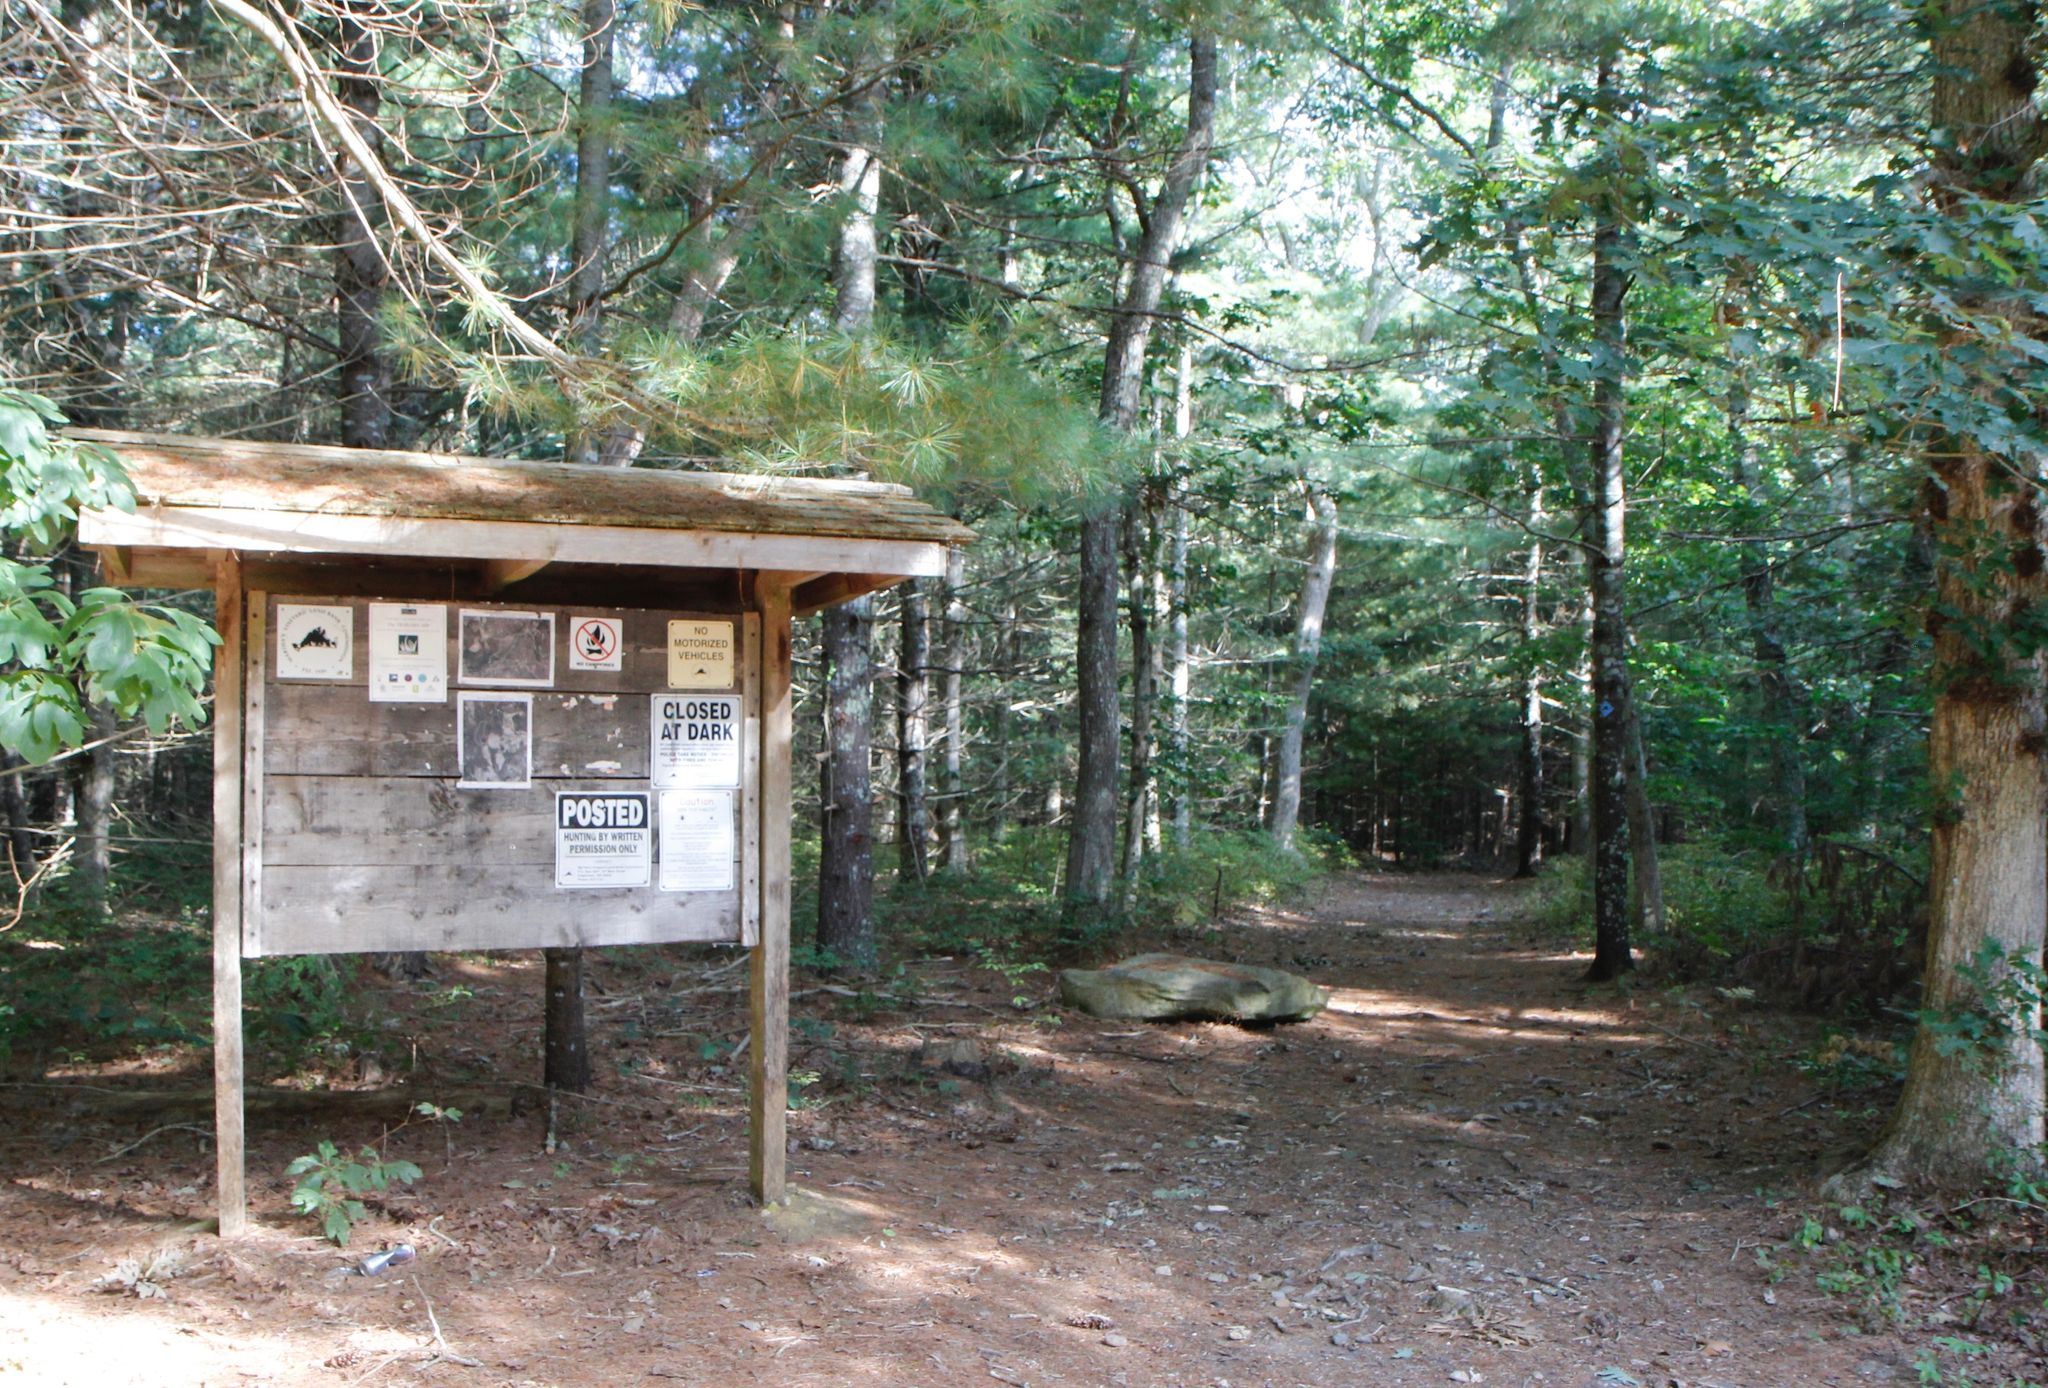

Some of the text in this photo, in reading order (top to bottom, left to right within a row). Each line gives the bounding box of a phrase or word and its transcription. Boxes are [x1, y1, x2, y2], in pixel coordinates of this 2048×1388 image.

[694, 626, 708, 635] NO
[674, 639, 728, 648] MOTORIZED
[678, 652, 724, 660] VEHICLES
[663, 702, 731, 720] CLOSED
[661, 723, 733, 740] AT DARK
[562, 798, 644, 827] POSTED
[564, 832, 643, 841] HUNTING BY WRITTEN
[569, 844, 637, 854] PERMISSION ONLY
